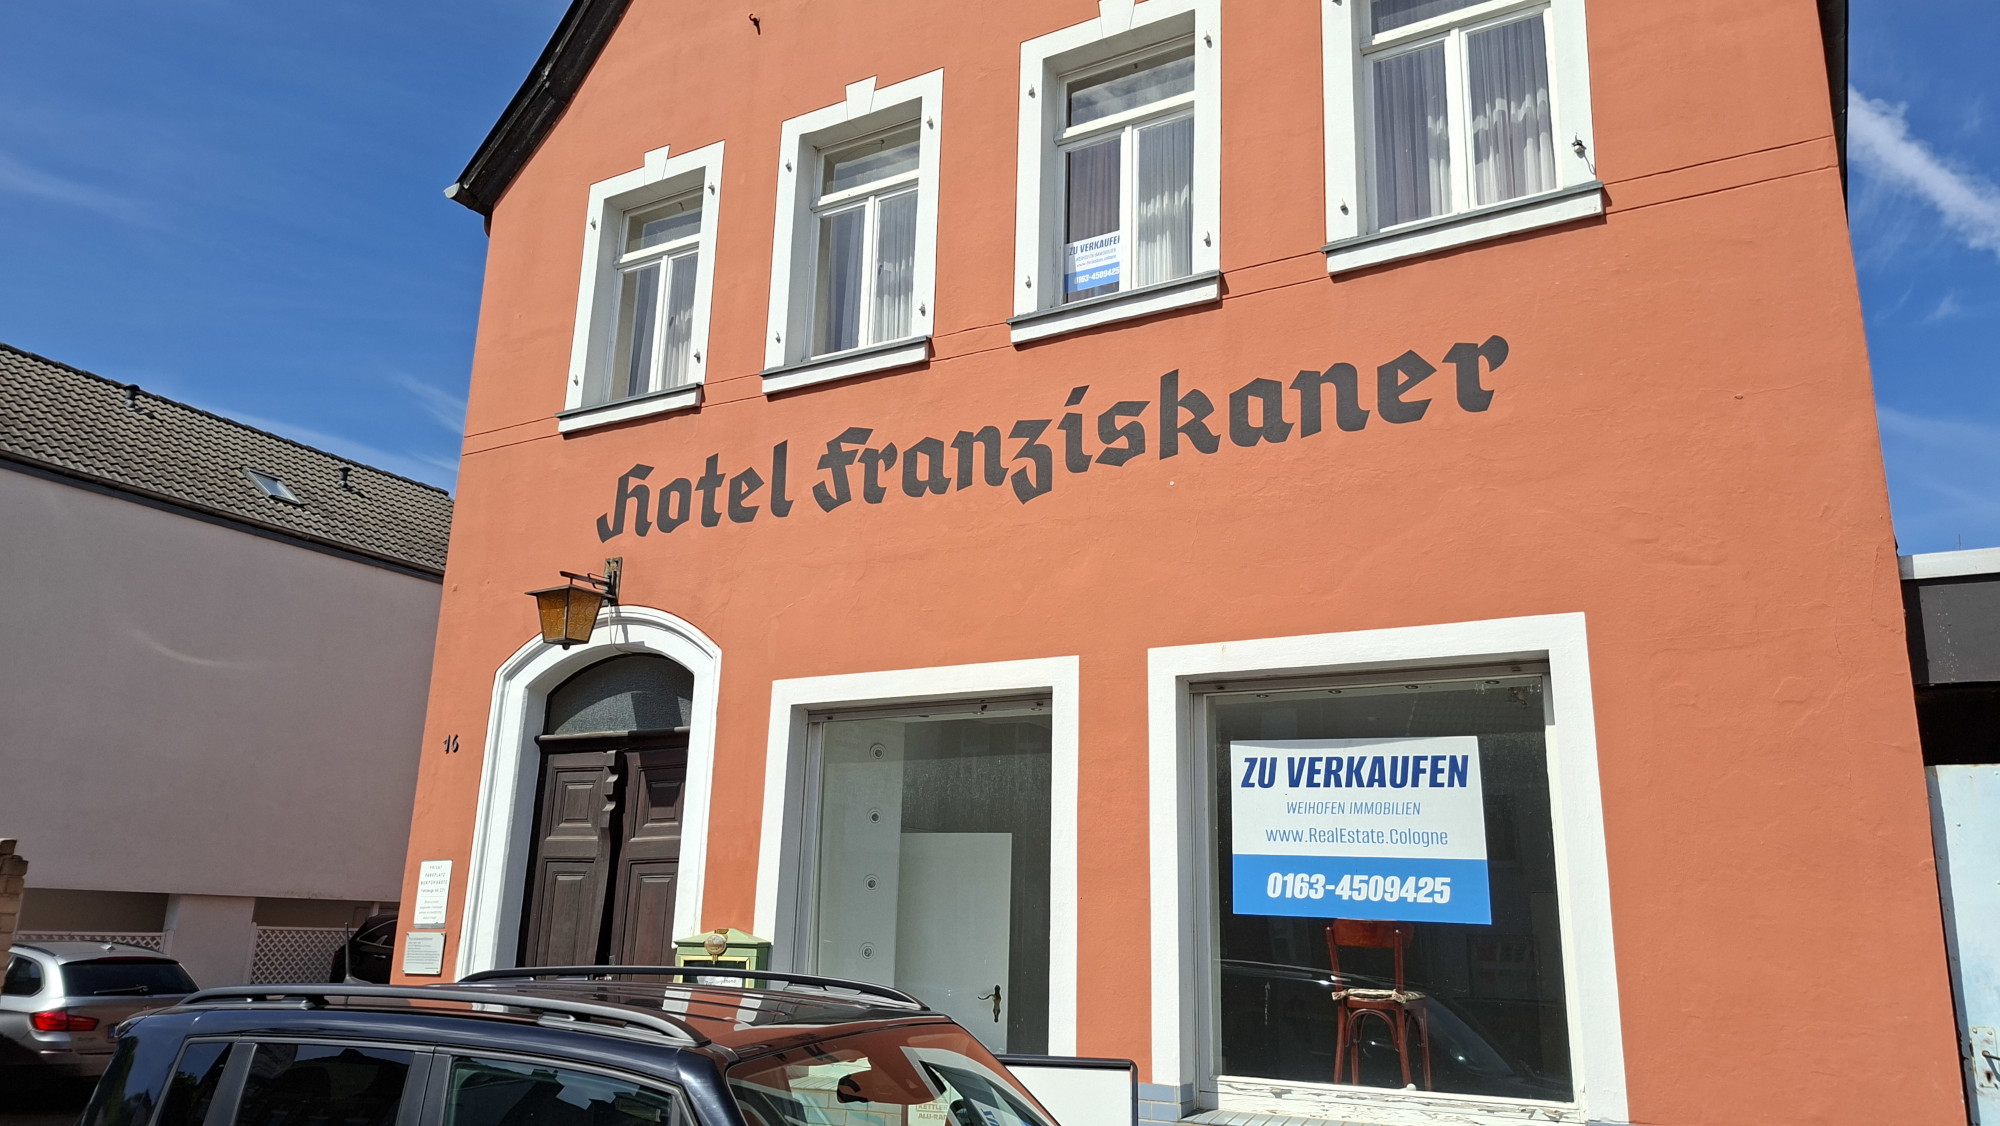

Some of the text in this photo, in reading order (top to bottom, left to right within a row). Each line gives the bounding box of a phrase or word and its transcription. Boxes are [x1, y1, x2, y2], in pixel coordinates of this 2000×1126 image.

[1069, 246, 1078, 256] ZU
[596, 335, 1510, 543] Hotel Franziskaner
[443, 734, 459, 754] 16
[1241, 755, 1469, 789] ZU VERKAUFEN
[1286, 801, 1421, 816] WEIHOFEN IMMOBILIEN
[1265, 827, 1448, 848] www.RealEstate.Cologne
[1266, 872, 1451, 904] 0163-4509425
